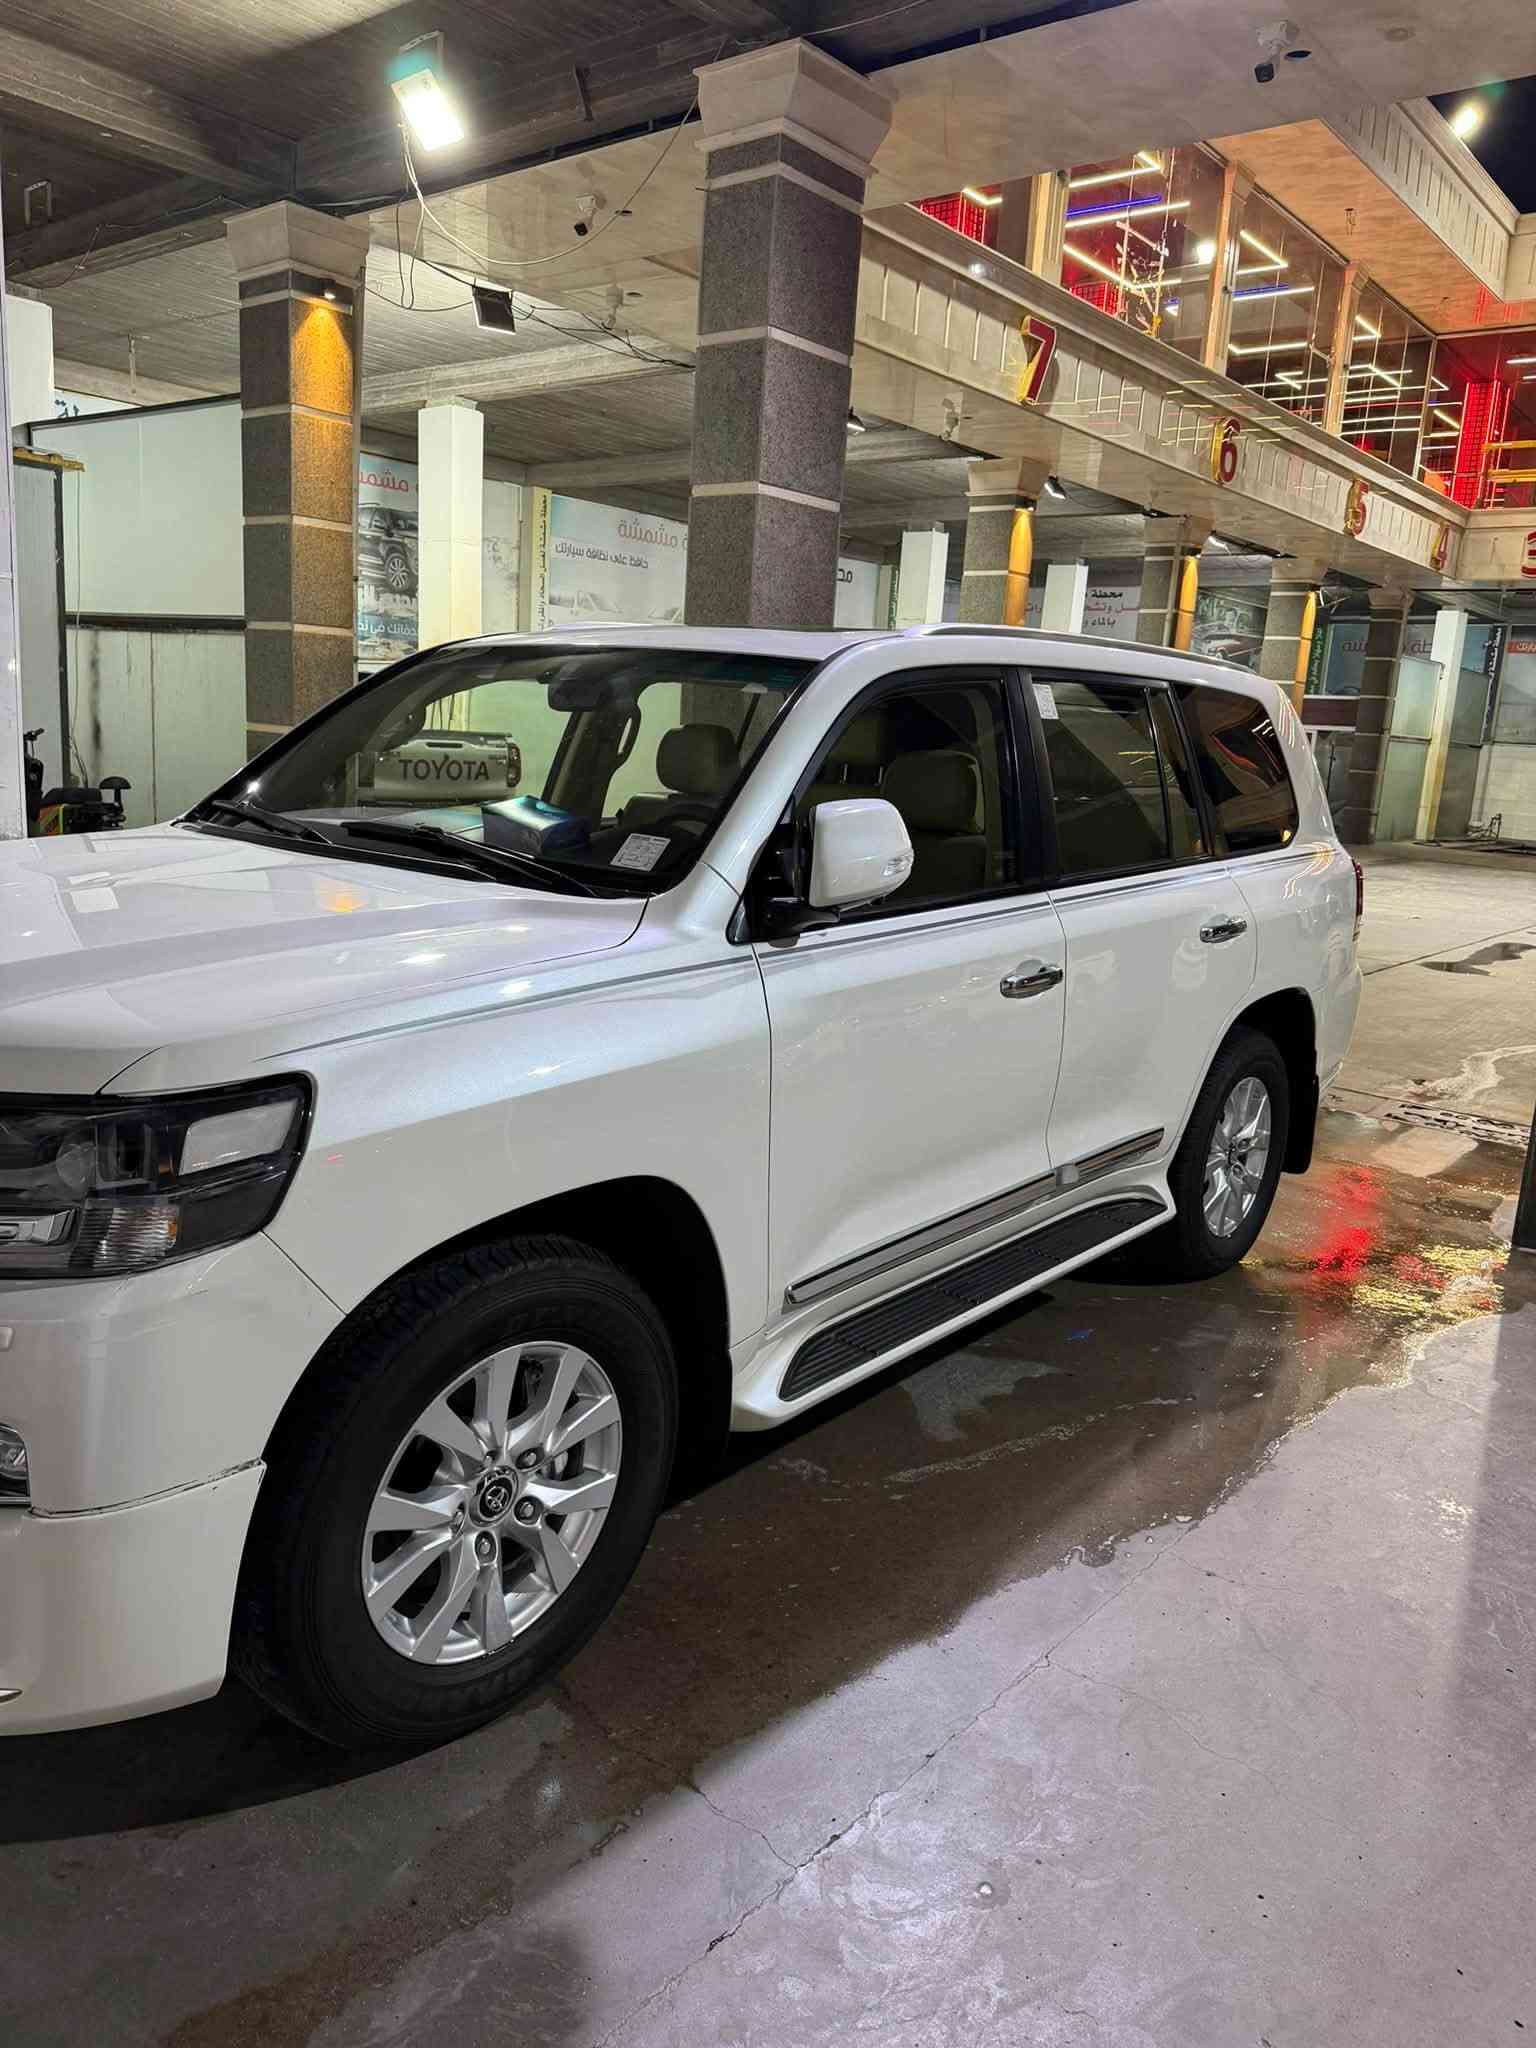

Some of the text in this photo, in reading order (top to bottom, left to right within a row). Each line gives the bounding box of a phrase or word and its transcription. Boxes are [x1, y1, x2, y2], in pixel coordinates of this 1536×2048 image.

[1020, 315, 1057, 404] 7
[1213, 416, 1241, 483] 6
[1347, 479, 1369, 537] 5
[555, 542, 584, 559] سيارتك
[617, 518, 679, 548] مشمشة
[1433, 525, 1450, 570] 4
[398, 759, 490, 780] TOYOTA
